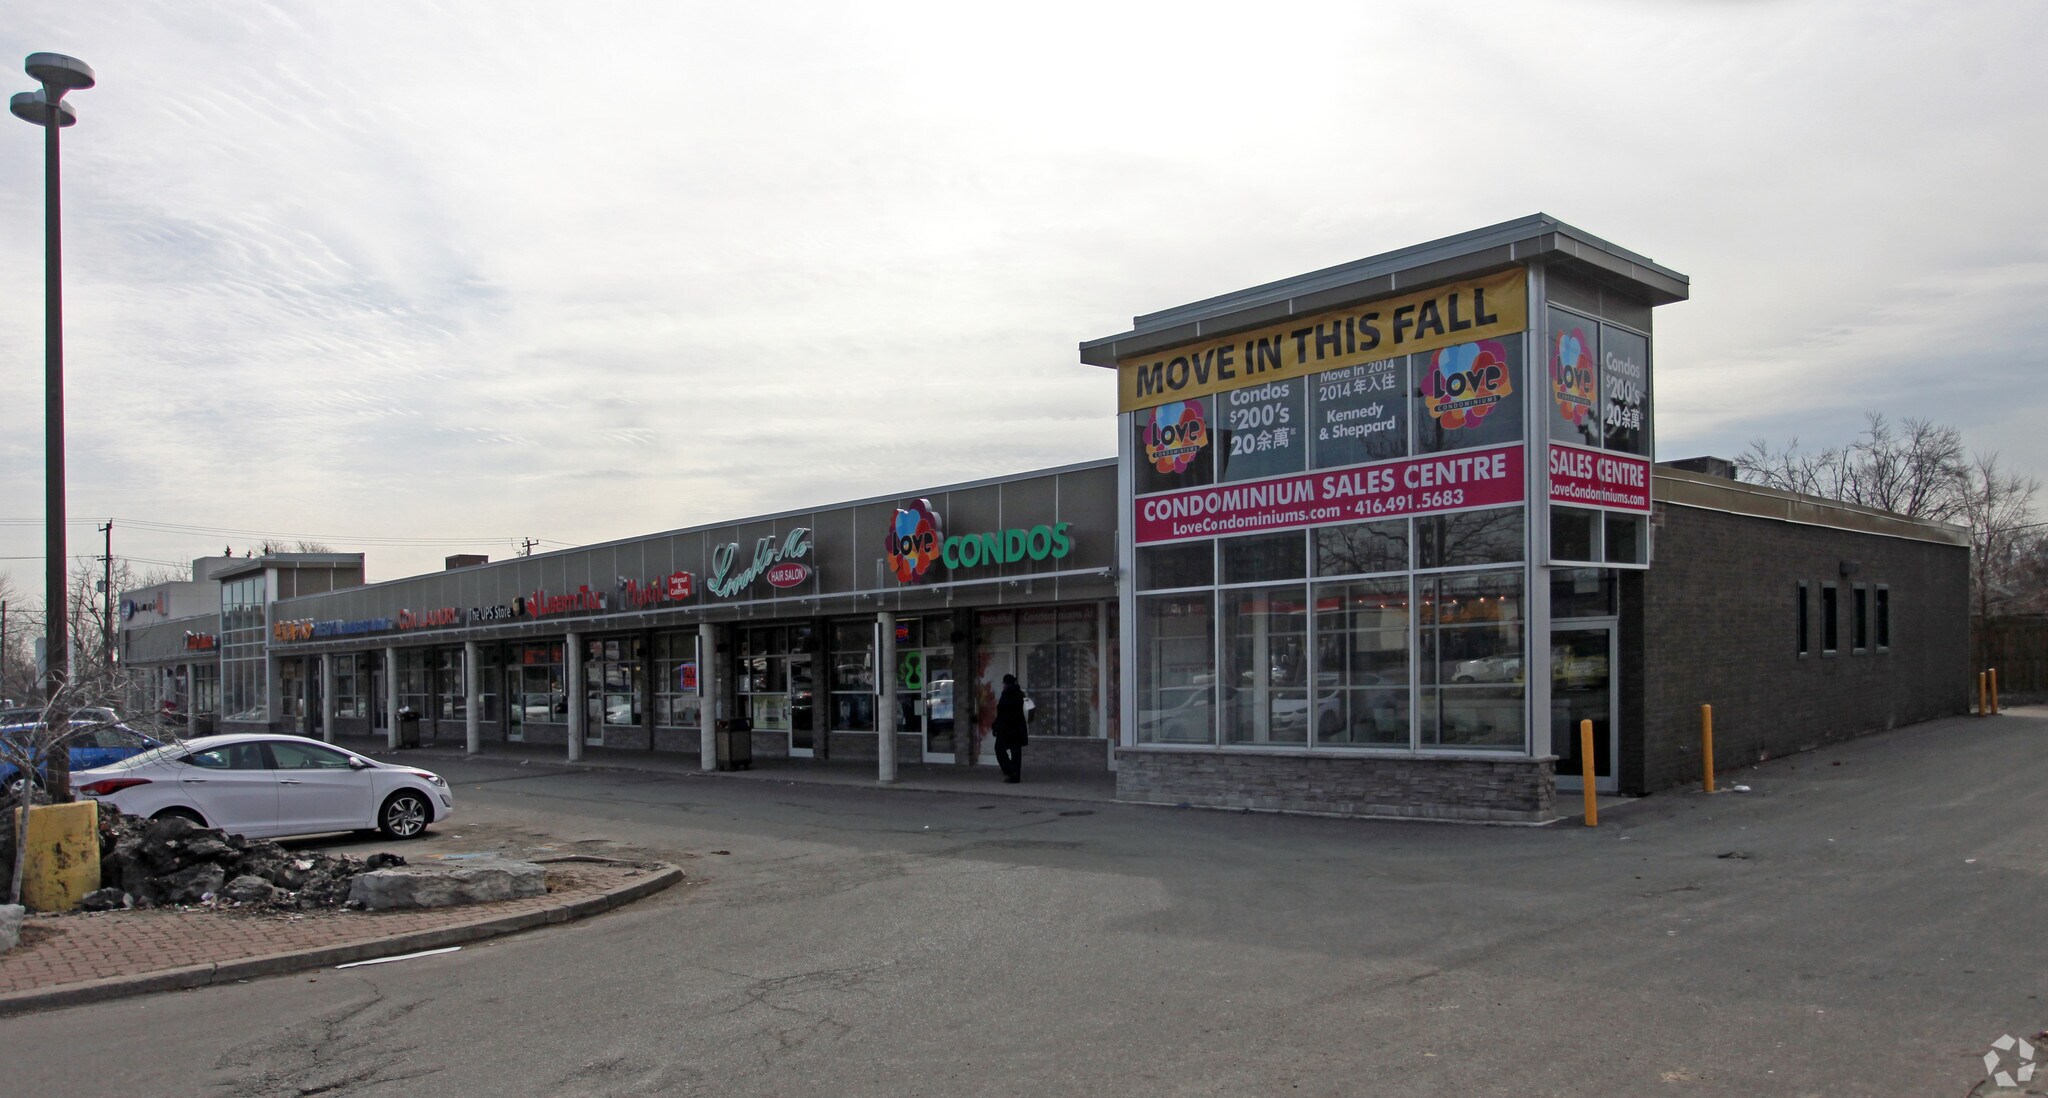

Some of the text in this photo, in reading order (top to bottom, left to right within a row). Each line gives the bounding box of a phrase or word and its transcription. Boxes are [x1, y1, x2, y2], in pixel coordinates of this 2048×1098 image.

[1137, 288, 1497, 398] MOVE IN THIS FALL
[1320, 359, 1394, 383] Move In 2014
[1606, 351, 1640, 379] Condos
[1230, 383, 1289, 406] Condos
[1606, 374, 1640, 405] $200's
[1230, 403, 1290, 430] $200's
[1327, 402, 1383, 423] Kennedy
[1437, 396, 1498, 411] CONDOMINIUMS
[1319, 416, 1396, 441] & Sheppard
[1155, 446, 1199, 458] CONDOMINIUMS
[1550, 449, 1644, 487] SALES CENTRE
[1144, 453, 1506, 522] CONDOMINIUM SALES CENTRE
[1550, 479, 1644, 506] LoveCondominiums.com
[1173, 489, 1464, 535] LoveCondominiums.com 416.491.5683
[775, 528, 808, 562] Me
[942, 521, 1070, 570] CONDOS
[671, 576, 688, 584] Takeout
[771, 568, 803, 582] HAIR SALON
[540, 585, 600, 615] LIBERTY TAX
[670, 587, 688, 596] Catering
[469, 606, 511, 621] The UPS Store
